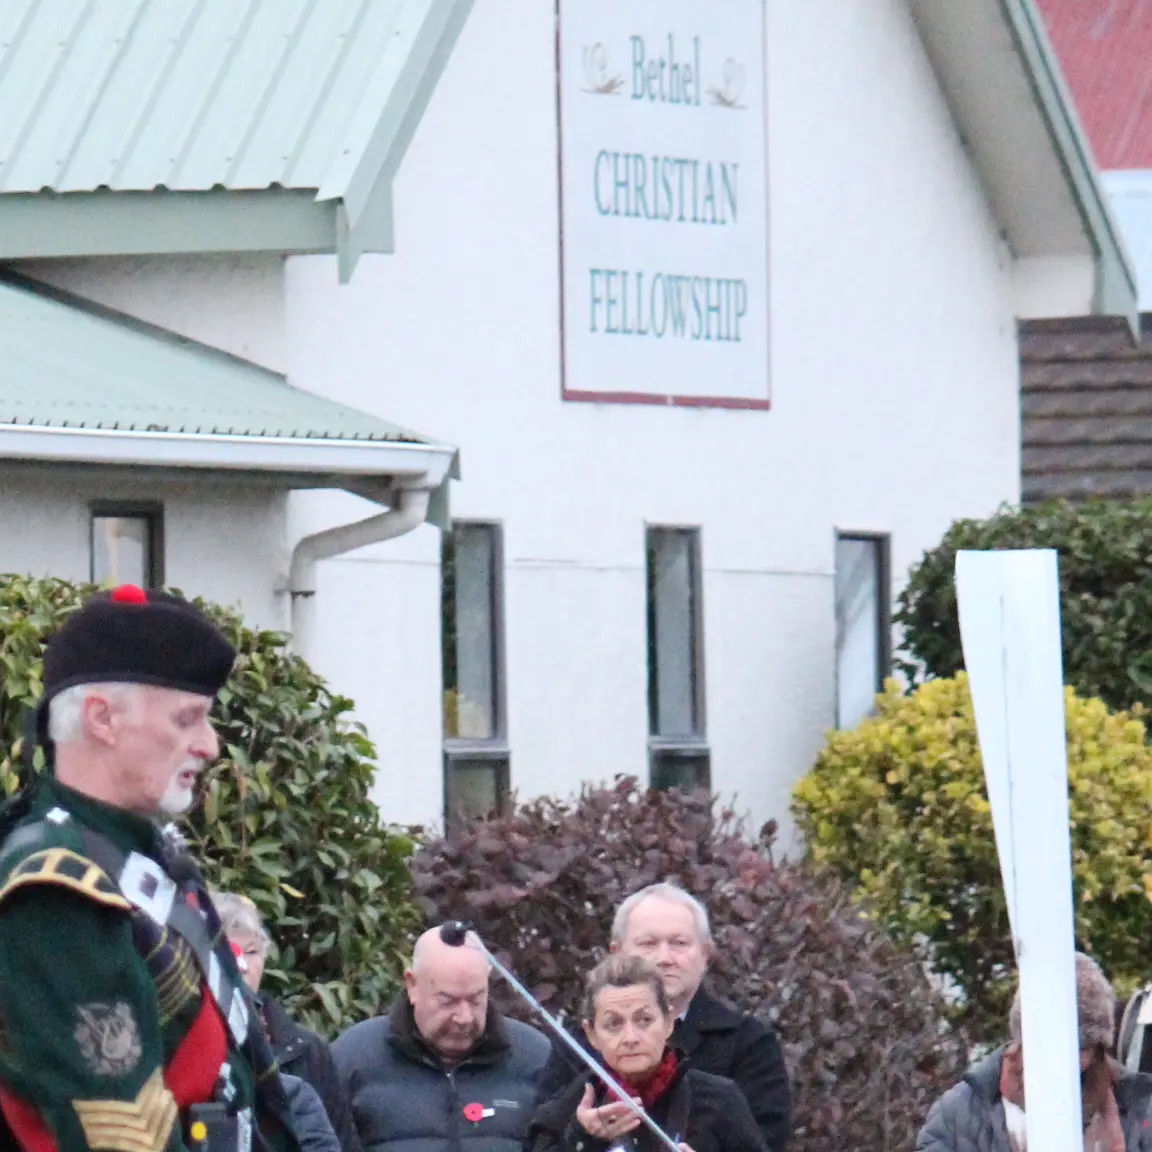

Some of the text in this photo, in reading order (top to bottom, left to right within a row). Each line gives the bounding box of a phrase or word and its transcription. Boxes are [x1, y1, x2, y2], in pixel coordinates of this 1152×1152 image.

[629, 33, 701, 107] Bethel
[593, 149, 739, 226] CHRISTIAN
[589, 268, 748, 342] FELLOWSHIP
